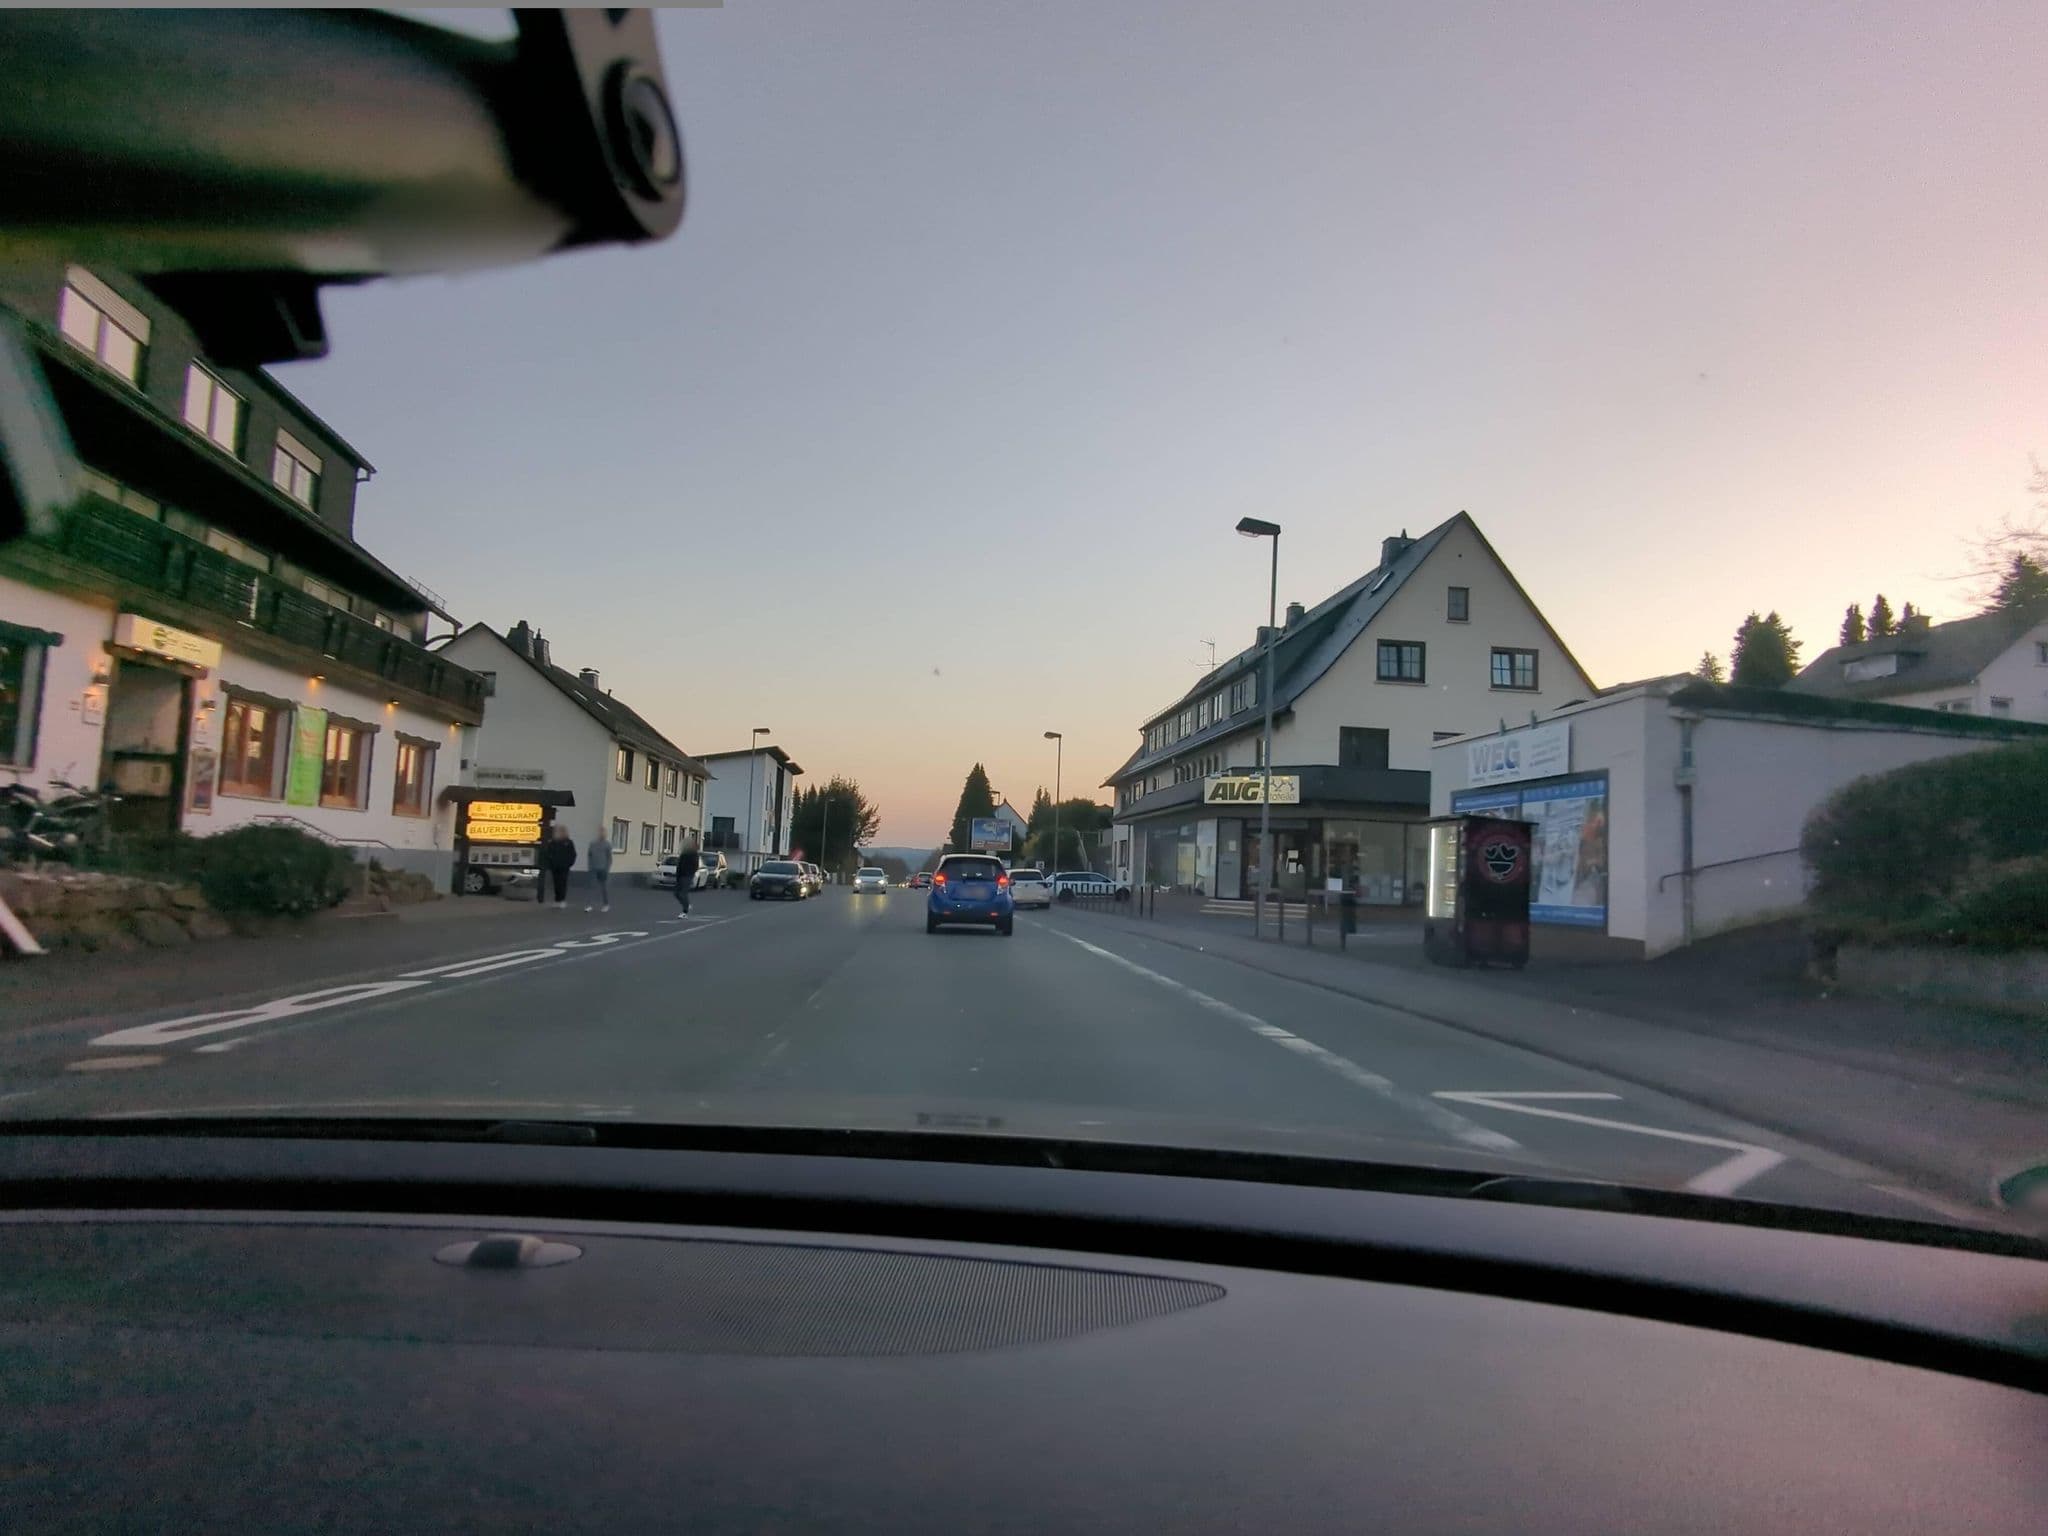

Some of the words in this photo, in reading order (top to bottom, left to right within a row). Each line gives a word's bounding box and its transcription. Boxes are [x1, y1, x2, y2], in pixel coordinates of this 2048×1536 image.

[1209, 782, 1260, 801] AVG
[489, 812, 538, 820] RESTAURANT
[87, 931, 648, 1046] BUS
